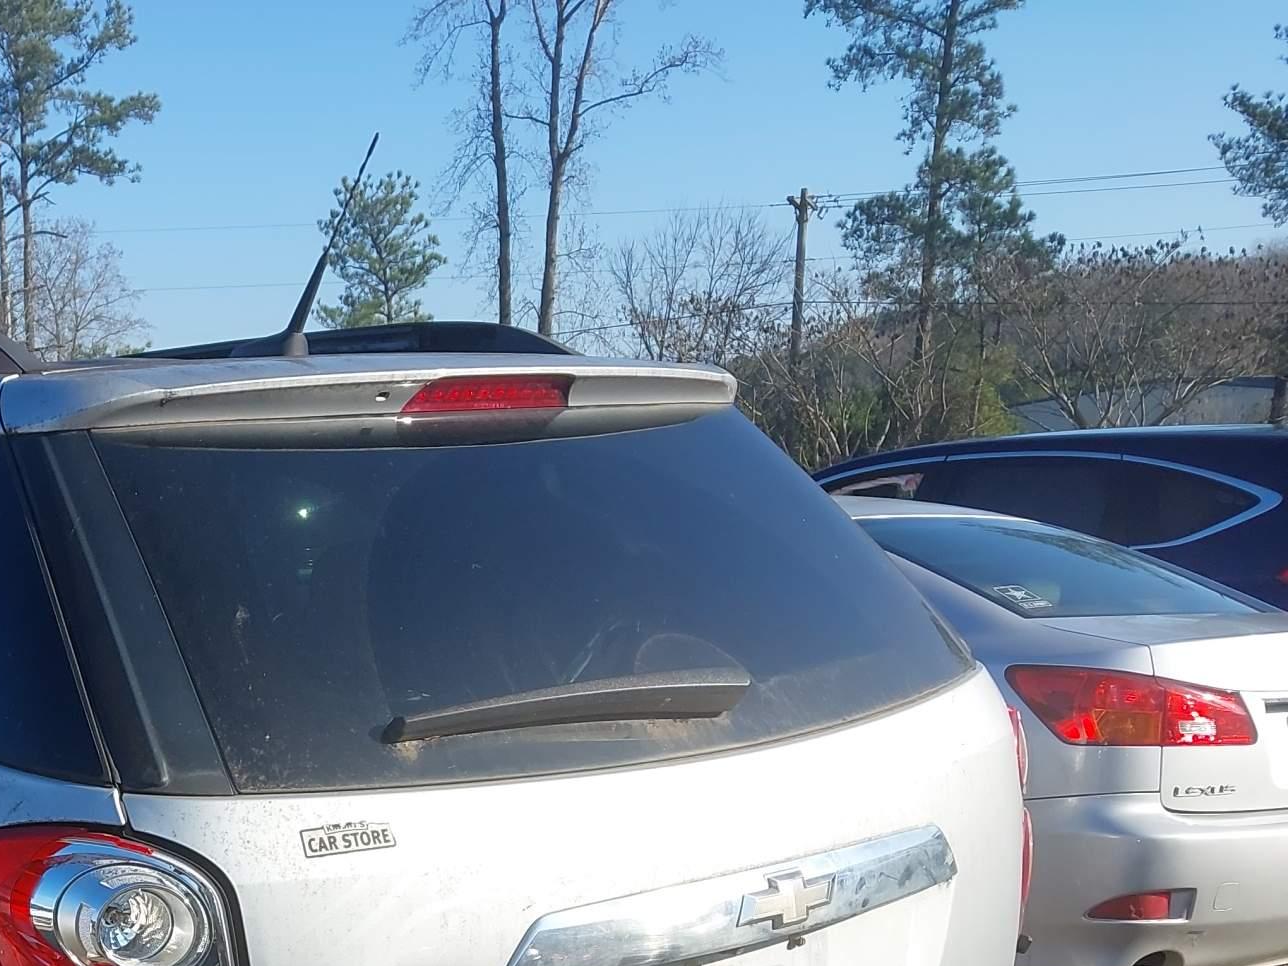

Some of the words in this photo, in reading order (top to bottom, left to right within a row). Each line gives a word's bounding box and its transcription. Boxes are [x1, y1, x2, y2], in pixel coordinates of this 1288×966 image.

[1172, 785, 1237, 798] LEXUS
[308, 835, 339, 853] CAR
[341, 828, 392, 848] STORE
